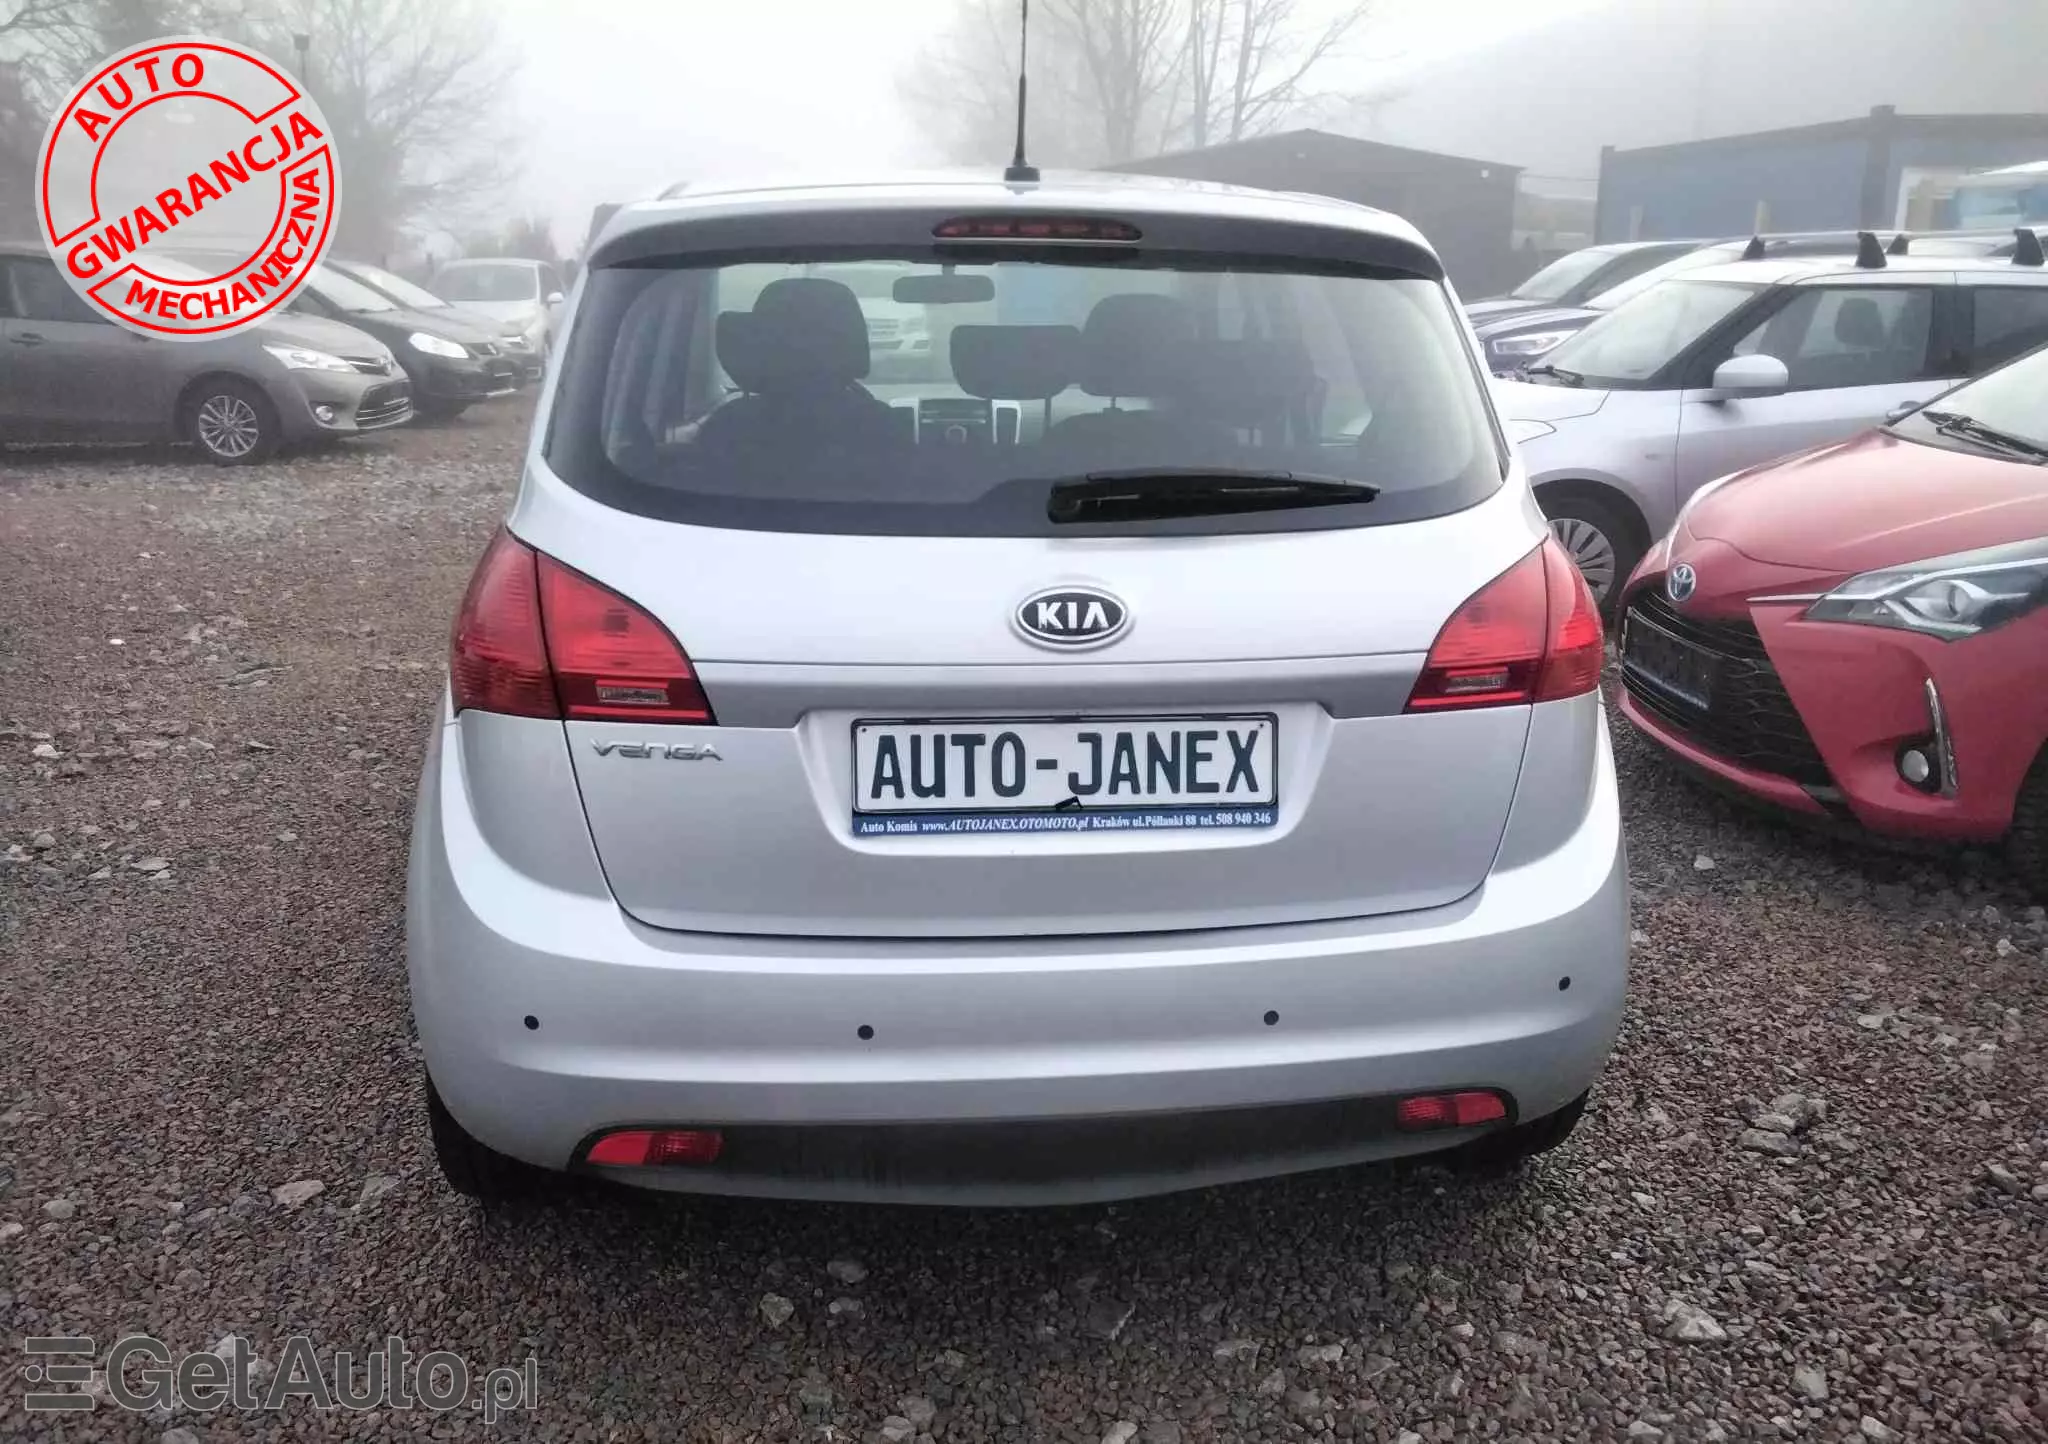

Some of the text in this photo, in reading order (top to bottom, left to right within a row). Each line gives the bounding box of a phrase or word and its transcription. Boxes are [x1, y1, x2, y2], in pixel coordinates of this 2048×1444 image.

[1036, 601, 1109, 629] KIA
[870, 730, 1260, 798] AUTO-JANEX
[860, 821, 885, 833] Auto
[886, 820, 918, 832] Komis
